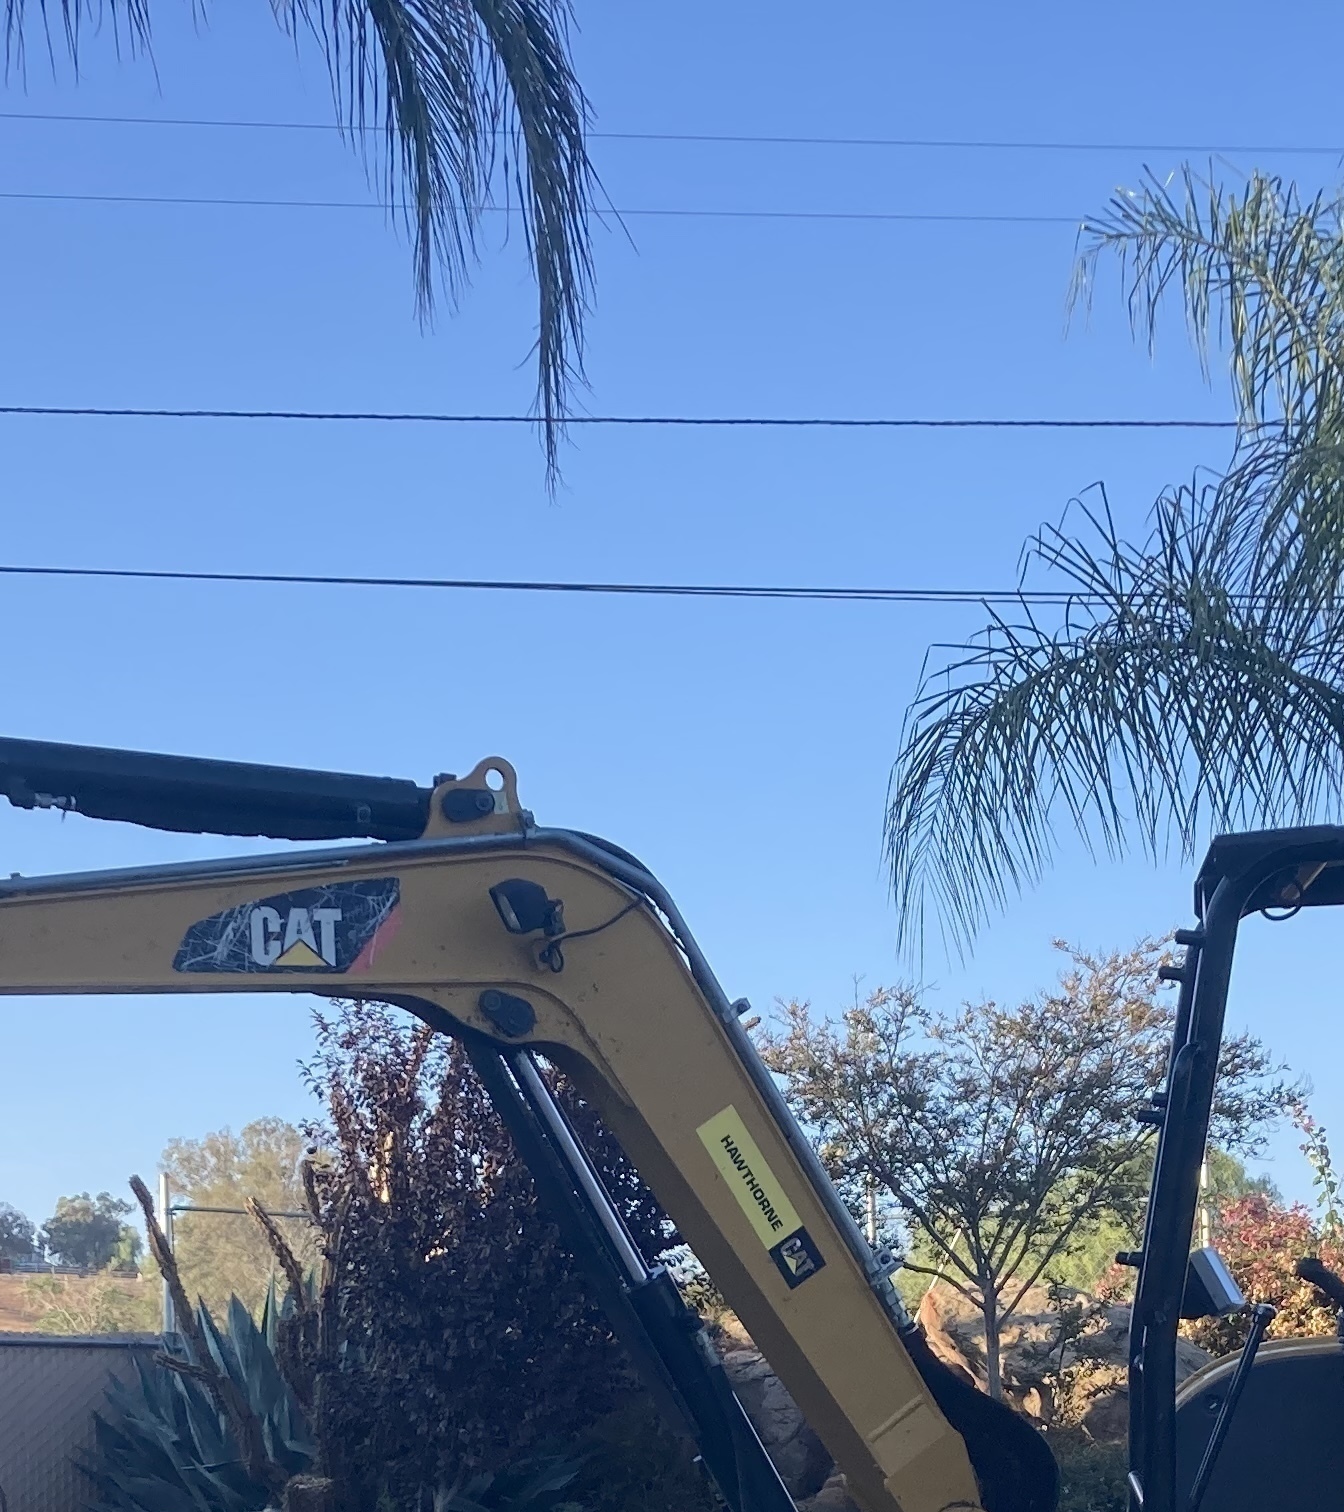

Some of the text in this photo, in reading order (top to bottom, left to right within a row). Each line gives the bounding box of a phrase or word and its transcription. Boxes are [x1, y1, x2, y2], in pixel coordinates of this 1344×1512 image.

[250, 905, 343, 967] CAT
[720, 1134, 815, 1277] HAWTHORNE CAT
